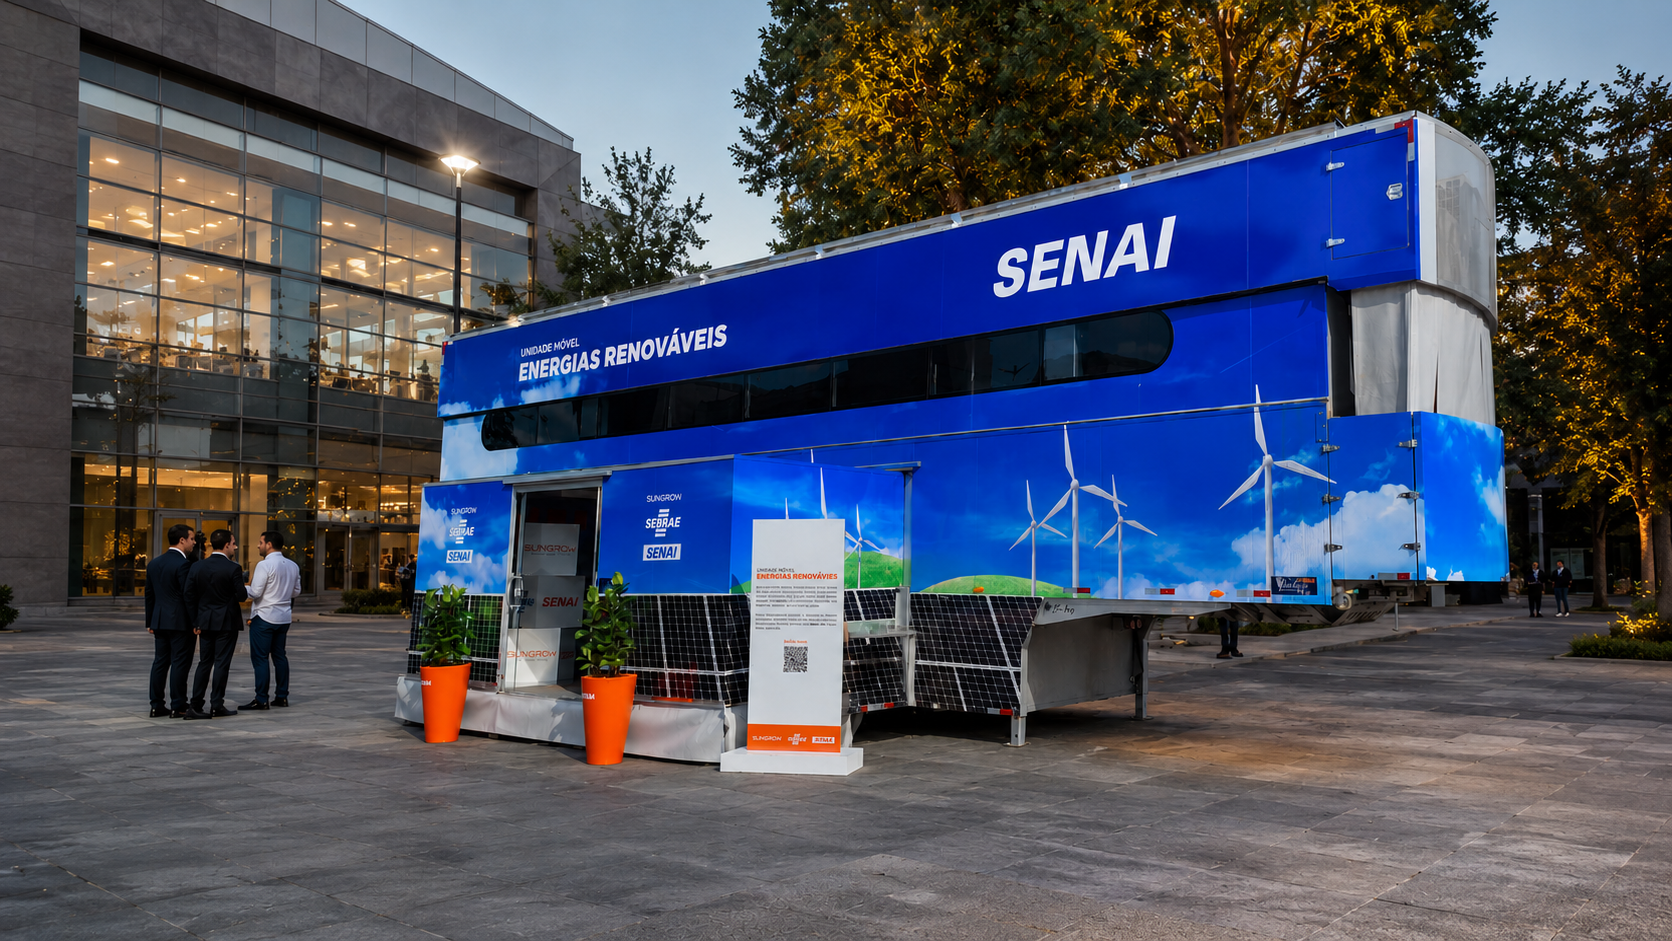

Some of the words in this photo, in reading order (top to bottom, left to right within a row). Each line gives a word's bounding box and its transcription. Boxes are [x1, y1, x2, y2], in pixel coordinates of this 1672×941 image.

[993, 215, 1176, 298] SENAI
[518, 349, 600, 382] ENERGIAS
[604, 324, 727, 367] RENOVÁVEIS
[521, 343, 552, 358] UNIDADE
[554, 337, 580, 351] MÓVEL
[646, 493, 682, 502] SUNGROW
[645, 517, 681, 529] SEBRAE
[524, 544, 576, 552] SUNGROW
[646, 546, 678, 559] SENAI
[447, 550, 471, 562] SENAI
[542, 597, 579, 607] SENAI
[507, 650, 557, 658] SUNGROW
